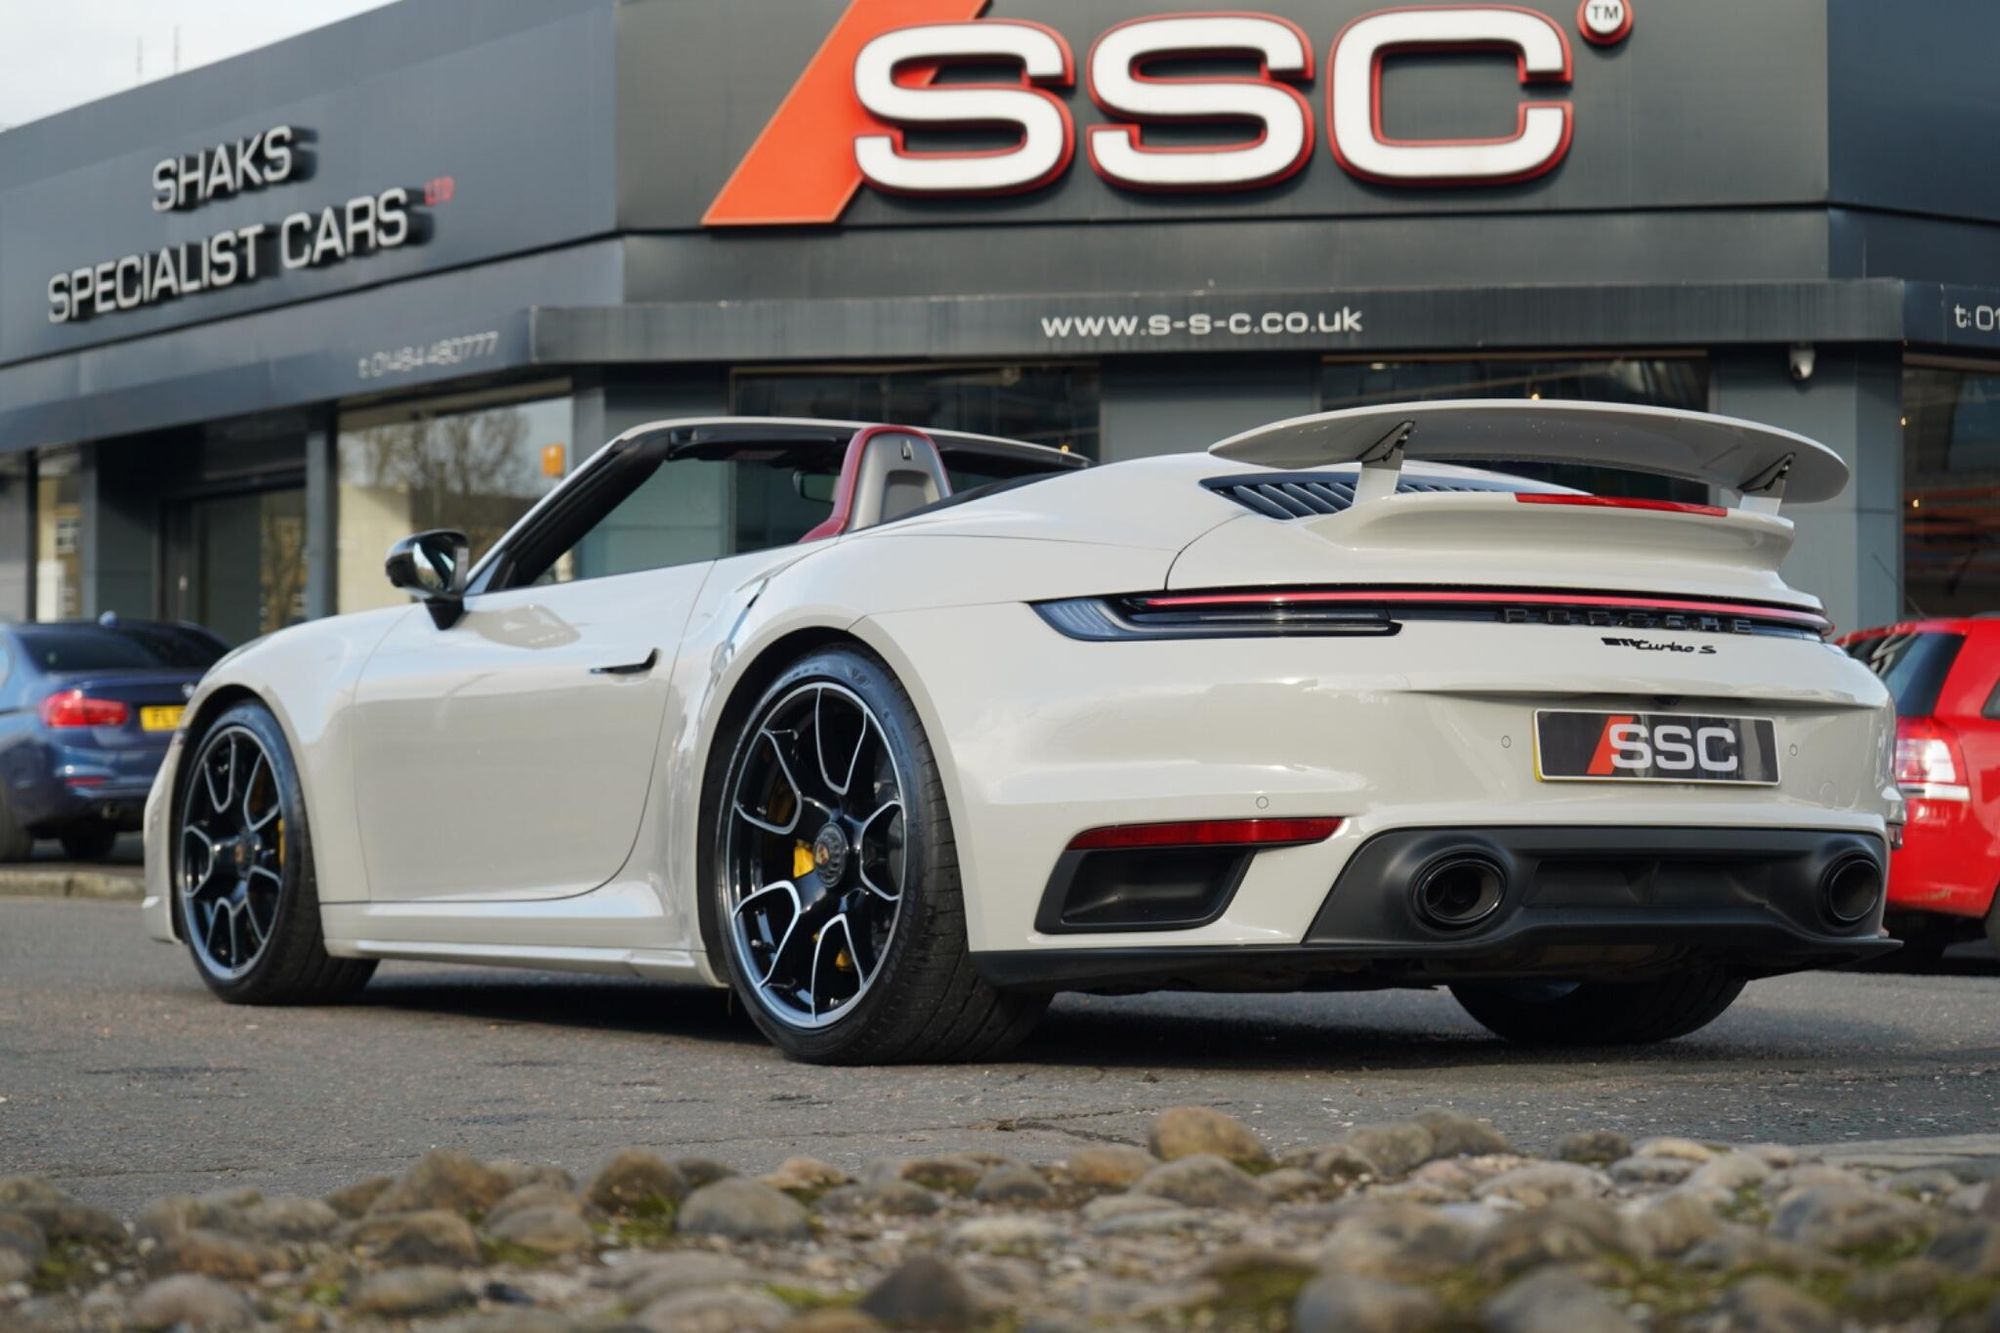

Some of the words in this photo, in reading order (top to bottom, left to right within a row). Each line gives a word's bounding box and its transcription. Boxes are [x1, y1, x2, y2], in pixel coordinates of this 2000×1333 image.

[854, 7, 1570, 194] SSC
[1592, 5, 1619, 20] TM
[152, 125, 296, 212] SHAKS
[48, 224, 266, 323] SPECIALIST
[281, 187, 410, 269] CARS
[1041, 306, 1363, 338] www.s-s-c.co.uk
[1504, 607, 1752, 633] PORSCHE
[1699, 645, 1717, 654] S
[1608, 723, 1739, 772] SSC
